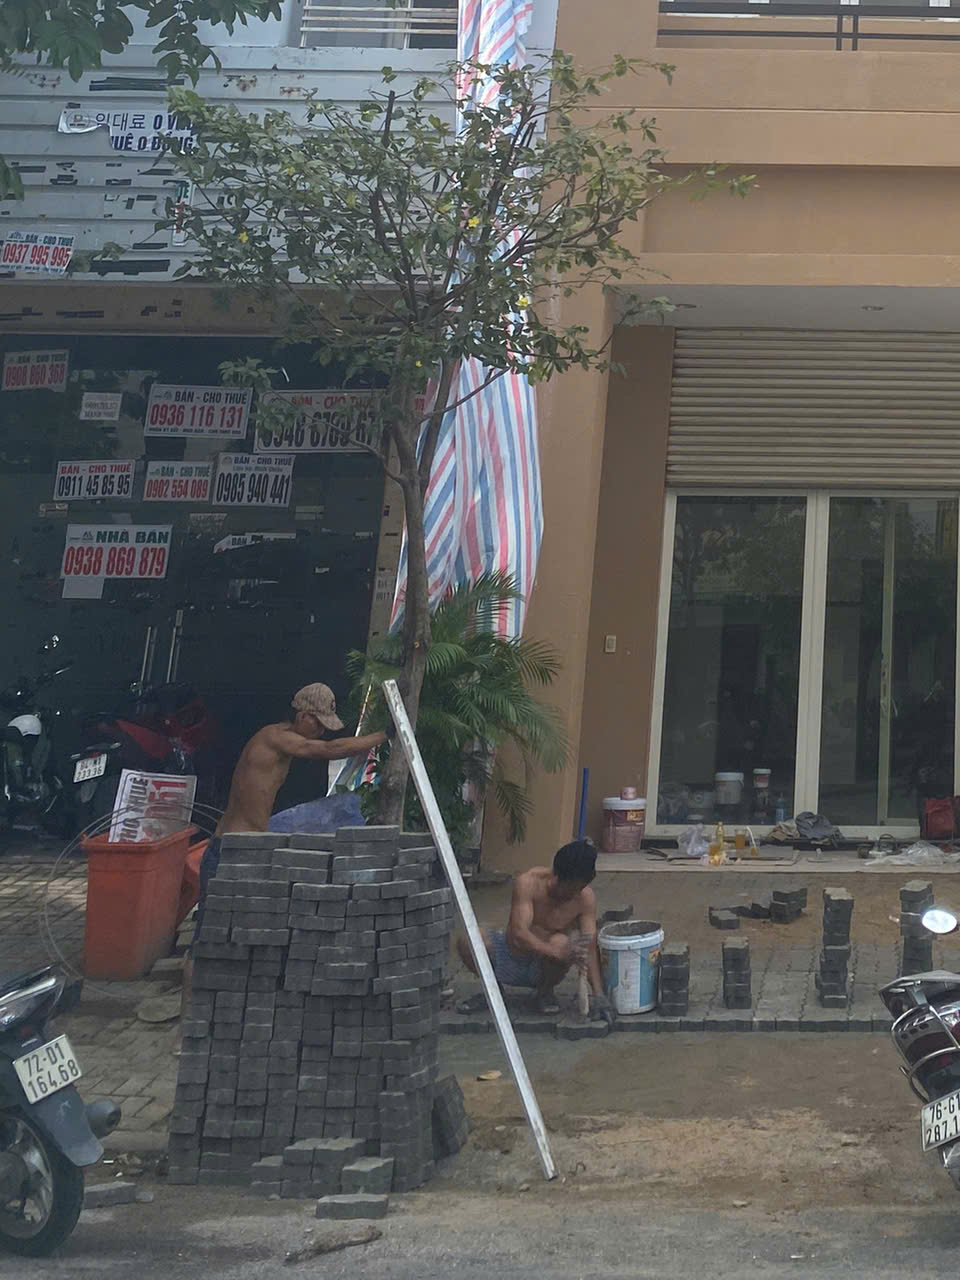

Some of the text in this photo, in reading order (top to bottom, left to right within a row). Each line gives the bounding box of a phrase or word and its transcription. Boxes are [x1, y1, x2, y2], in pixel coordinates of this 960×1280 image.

[3, 243, 71, 267] 0937 995 995
[174, 390, 247, 404] BÁN CHO THUÊ
[150, 404, 243, 429] 0936 116 131
[88, 465, 106, 473] CHO
[58, 474, 130, 496] 0911 45 85 95
[147, 479, 170, 498] 0902
[216, 472, 290, 504] 0985 940 441
[96, 529, 169, 543] NHÀ BÁN
[64, 546, 166, 576] 0938 869 879
[23, 1042, 65, 1077] 72-D1
[28, 1059, 79, 1098] 164.68
